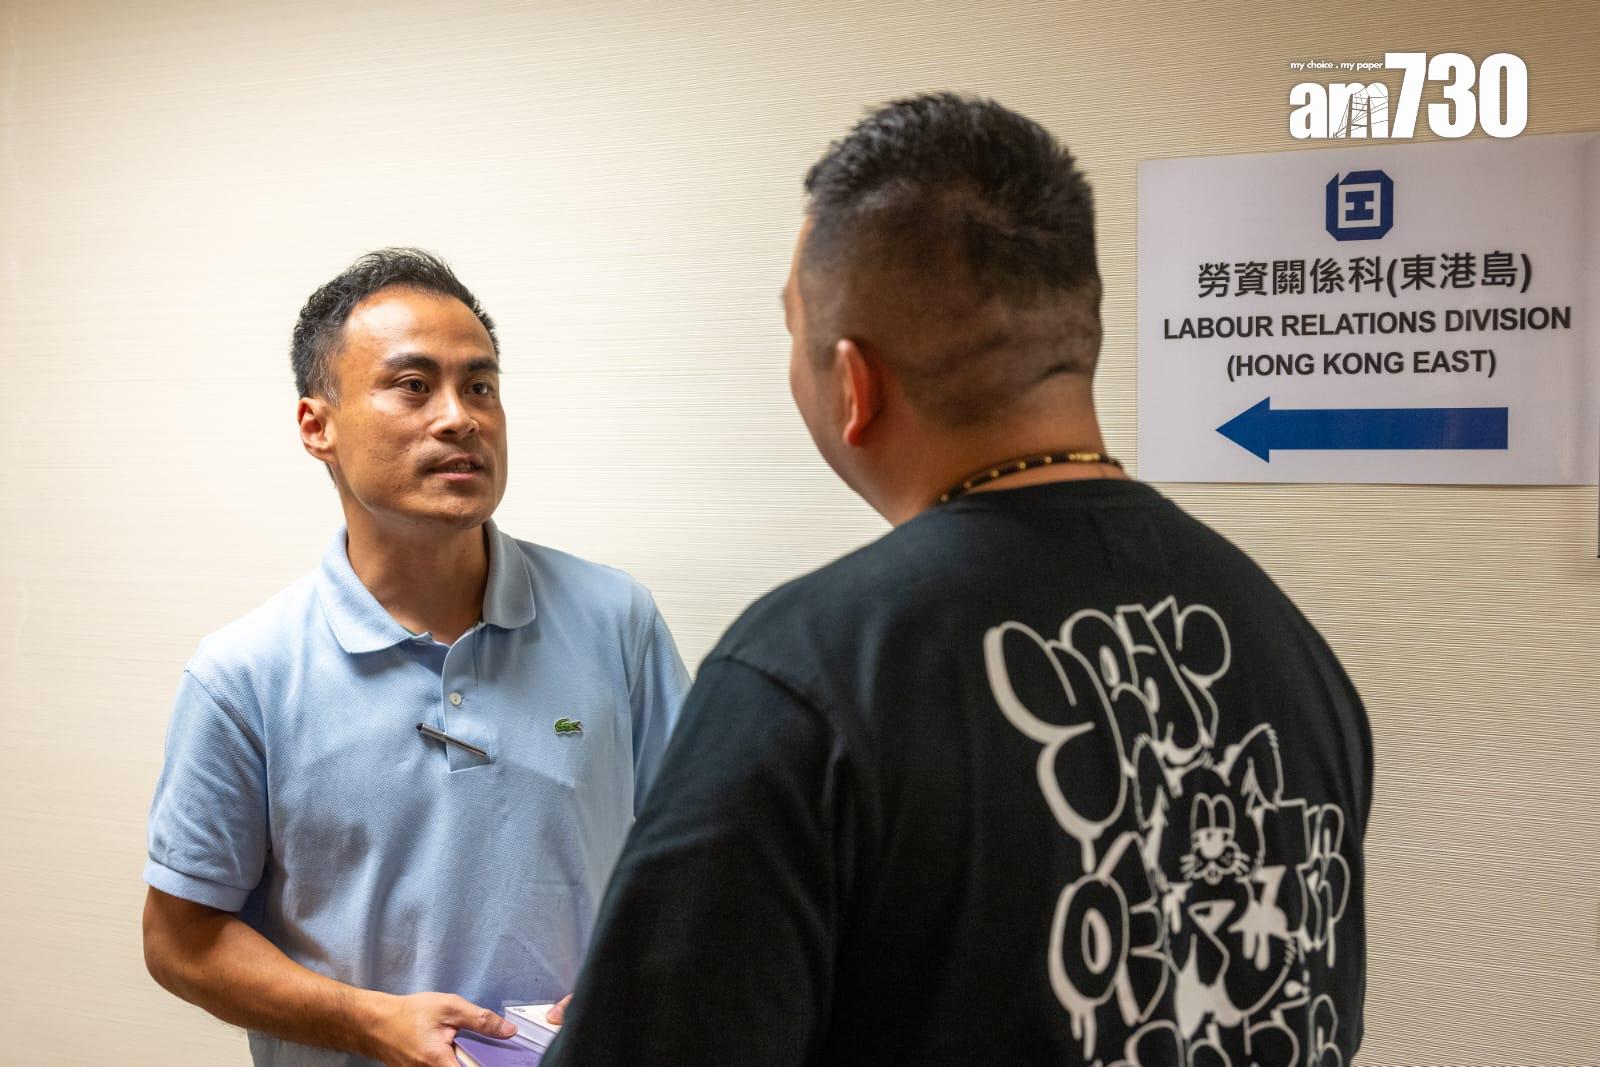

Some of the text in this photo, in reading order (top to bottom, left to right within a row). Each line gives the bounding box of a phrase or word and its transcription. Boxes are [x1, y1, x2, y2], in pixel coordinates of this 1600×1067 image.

[1198, 251, 1532, 297] 勞資關係科(東港島)
[1165, 307, 1570, 339] LABOUR RELATIONS DIVISION
[1227, 350, 1496, 382] (HONG KONG EAST)
